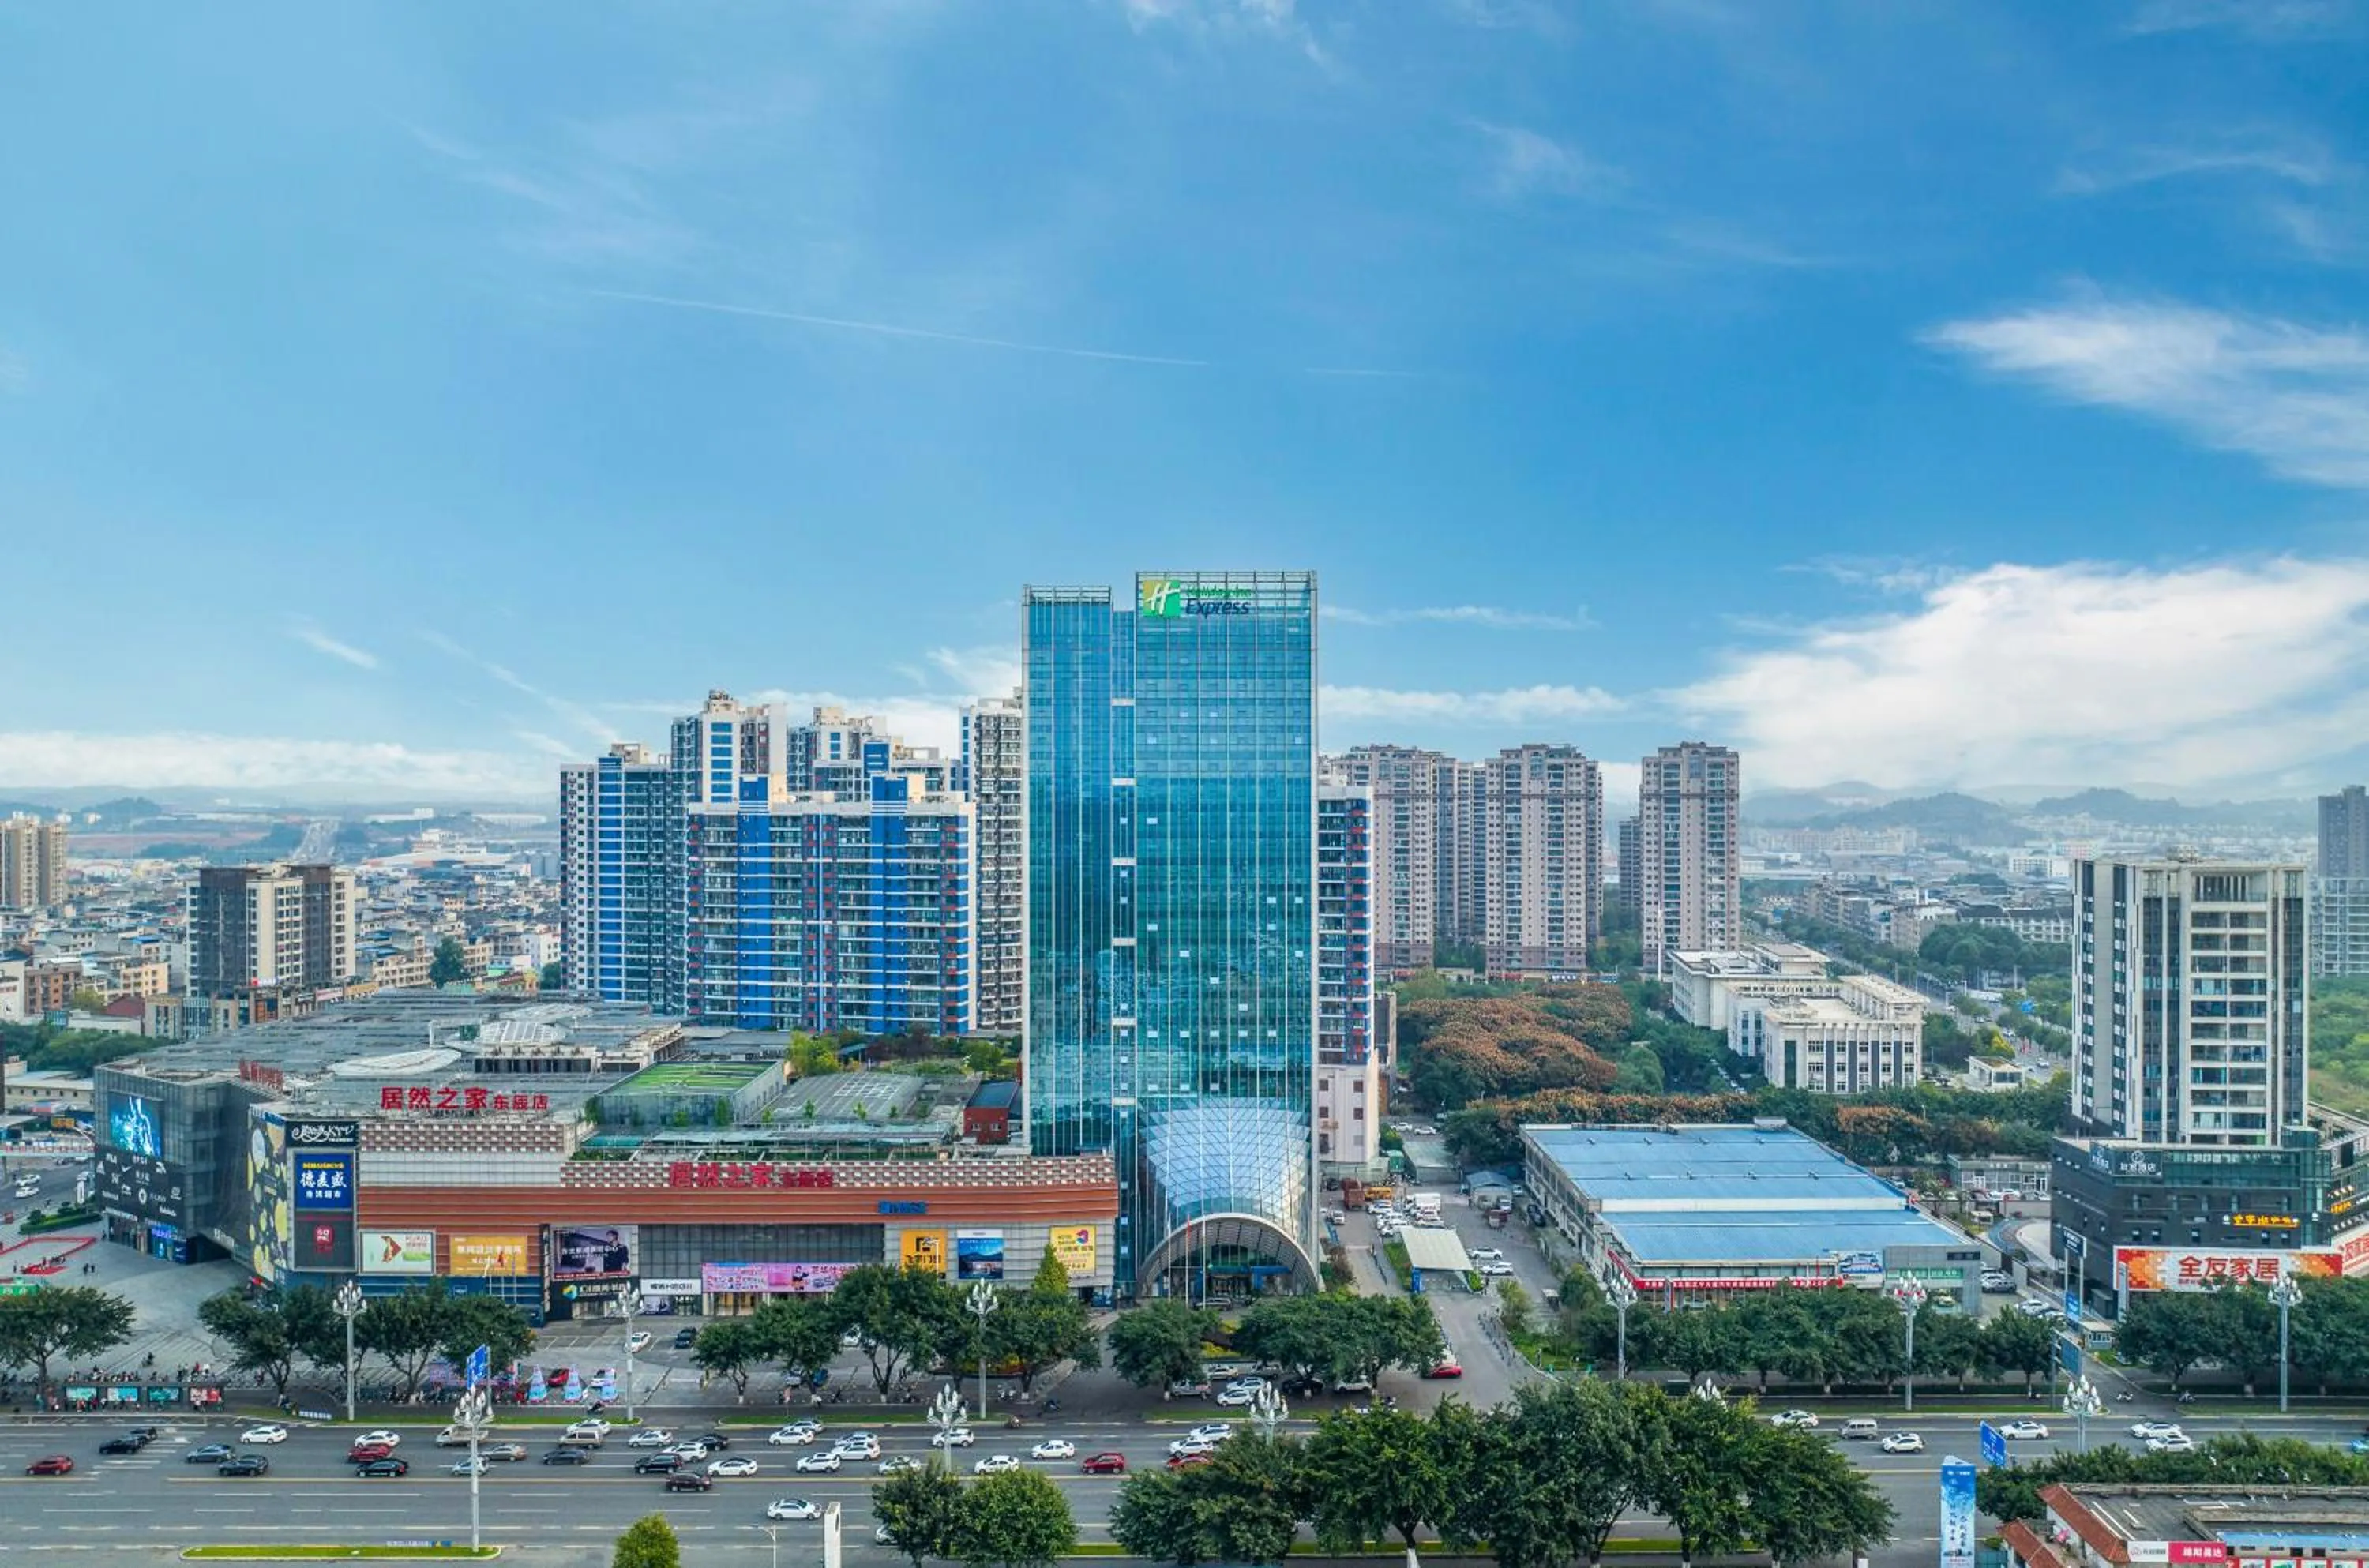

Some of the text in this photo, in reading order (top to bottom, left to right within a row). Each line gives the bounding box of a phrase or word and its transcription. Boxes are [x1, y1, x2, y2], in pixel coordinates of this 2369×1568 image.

[1185, 598, 1252, 619] Express
[381, 1086, 489, 1109] 居然之家
[670, 1162, 773, 1187] 居然之家
[2179, 1256, 2279, 1279] 全友家居
